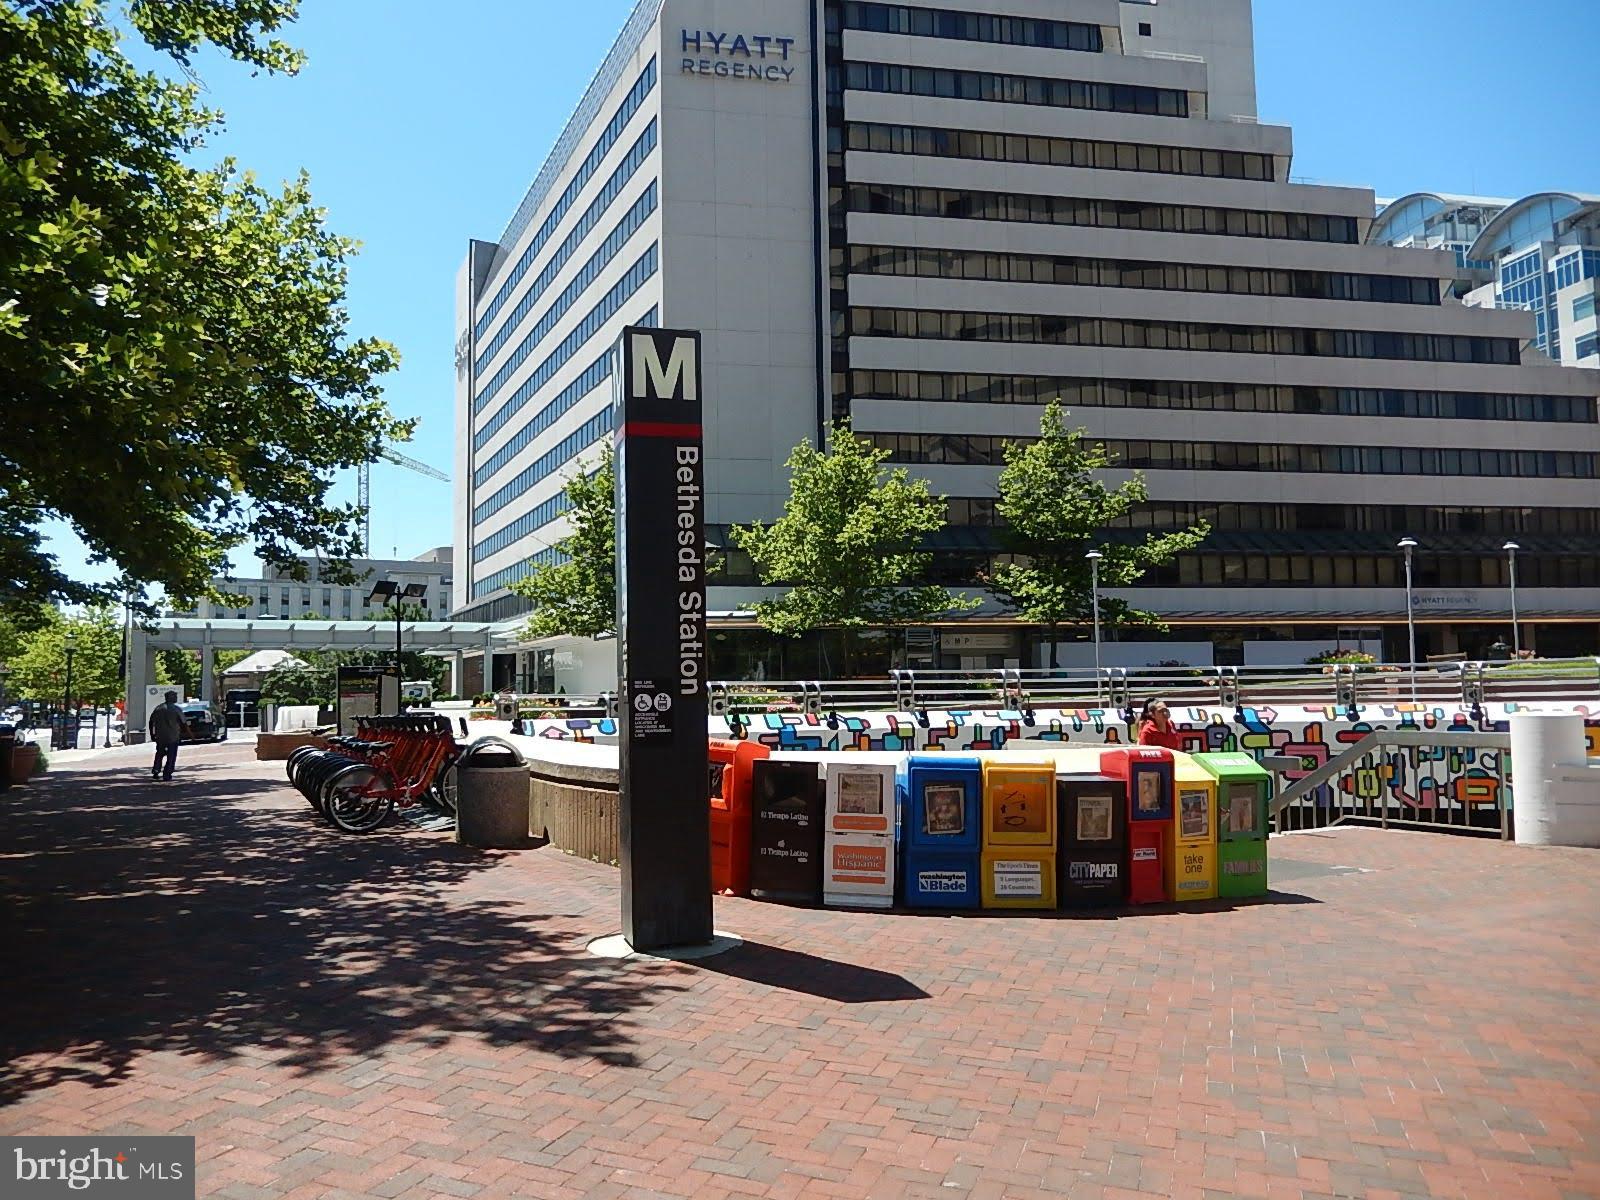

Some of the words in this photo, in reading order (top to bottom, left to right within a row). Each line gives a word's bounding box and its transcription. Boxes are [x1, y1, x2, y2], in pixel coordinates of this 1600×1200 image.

[681, 29, 795, 61] HYATT
[681, 58, 795, 82] REGENCY
[631, 333, 697, 401] M
[676, 446, 701, 582] Bethesda
[678, 591, 703, 695] Station
[768, 811, 790, 821] Tiempo
[767, 847, 789, 858] Tiempo
[789, 849, 809, 858] Latino
[837, 851, 882, 862] Washington
[837, 859, 880, 869] Hispanic
[1184, 853, 1204, 865] take
[1184, 864, 1203, 873] one
[920, 873, 966, 882] washington
[929, 880, 966, 891] Blade
